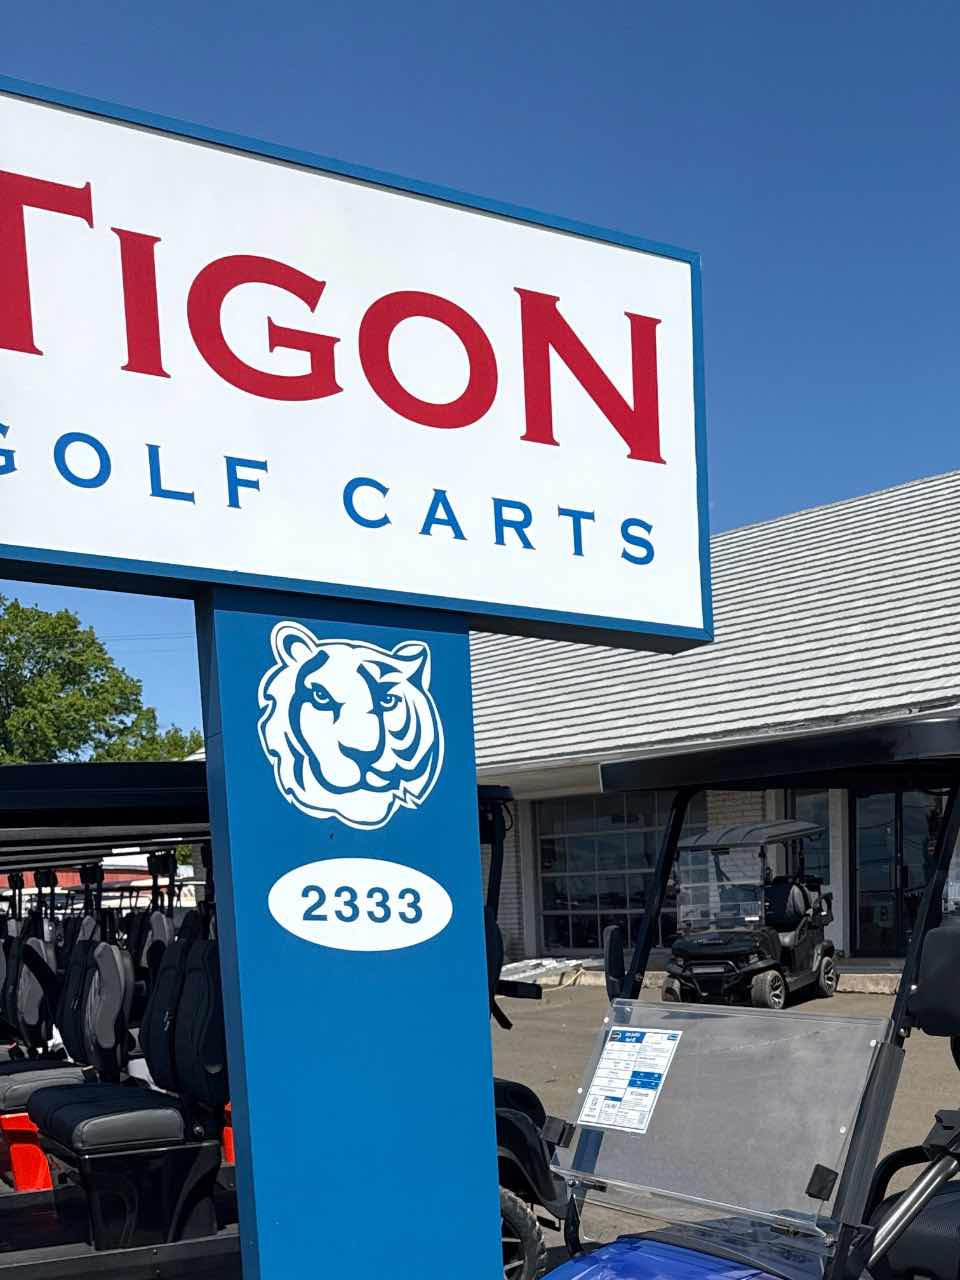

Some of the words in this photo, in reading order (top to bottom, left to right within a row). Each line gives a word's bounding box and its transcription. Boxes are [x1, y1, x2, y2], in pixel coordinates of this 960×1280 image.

[0, 170, 667, 465] TIGON
[342, 476, 657, 567] CARTS
[301, 884, 423, 924] 2333
